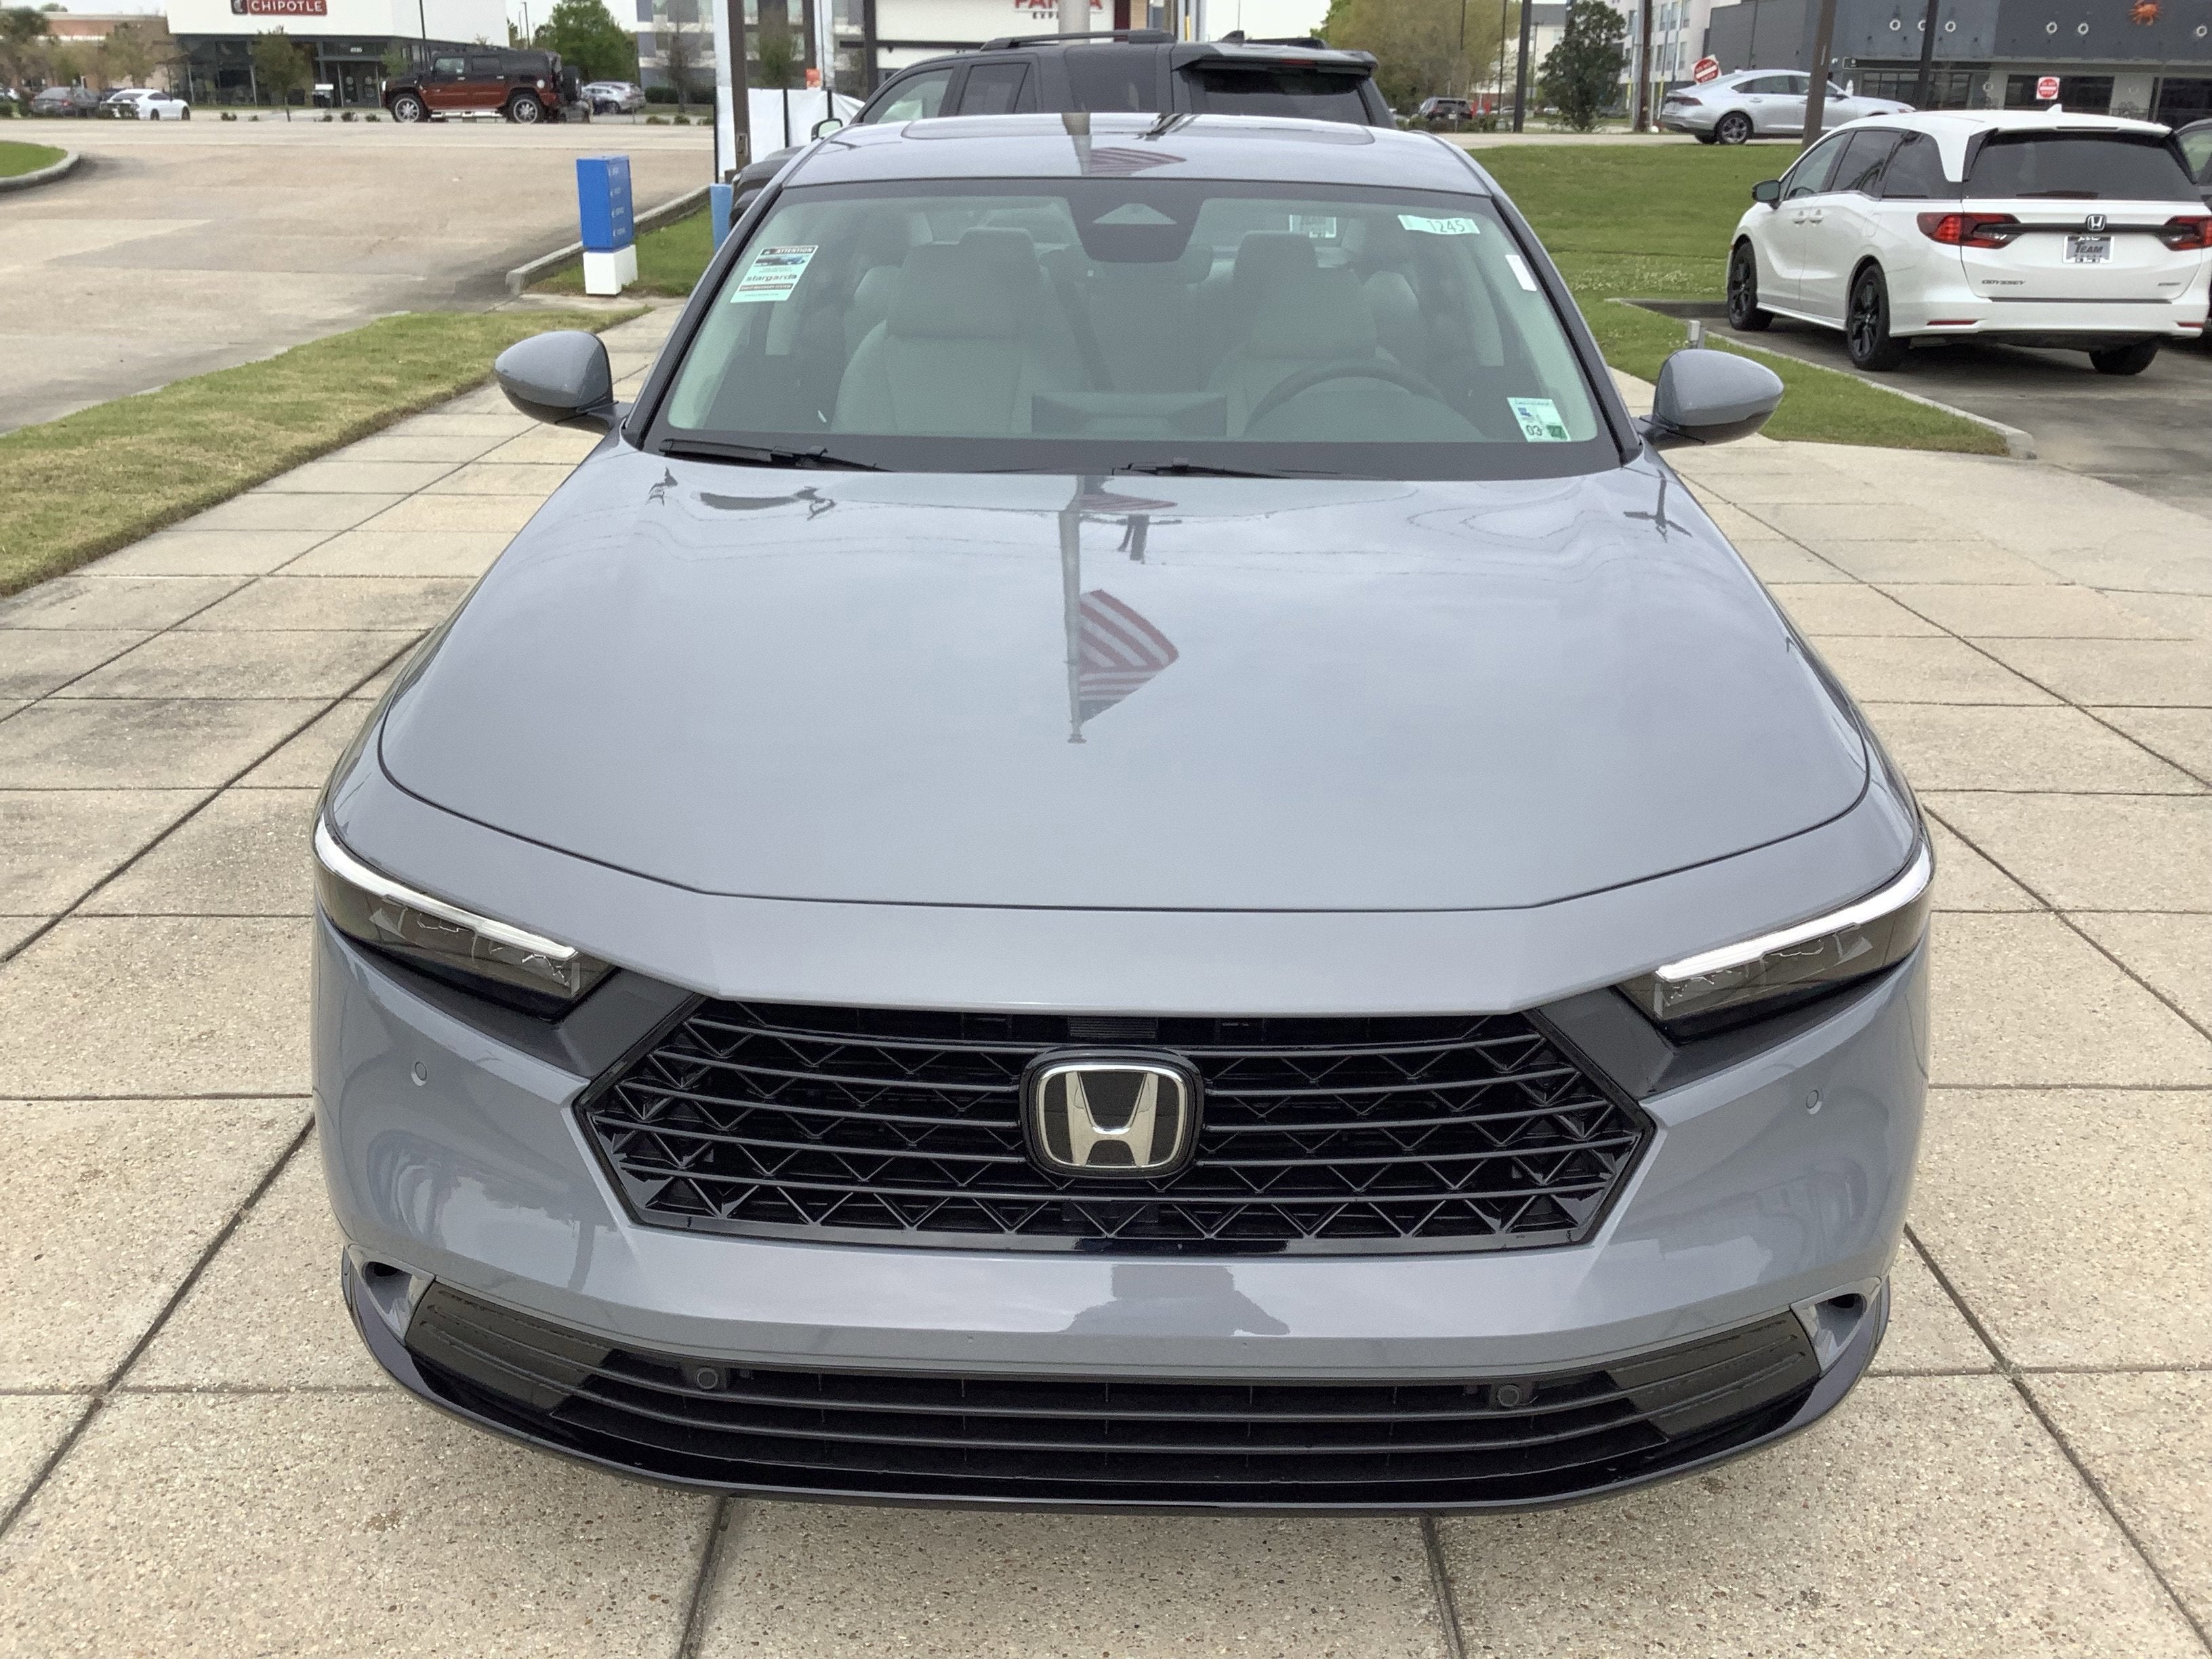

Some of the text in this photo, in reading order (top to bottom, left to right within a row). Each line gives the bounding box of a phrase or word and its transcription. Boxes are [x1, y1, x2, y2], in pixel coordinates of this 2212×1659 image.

[251, 0, 323, 12] CHIPOTLE
[1427, 220, 1466, 232] 1245
[1526, 425, 1542, 436] 03
